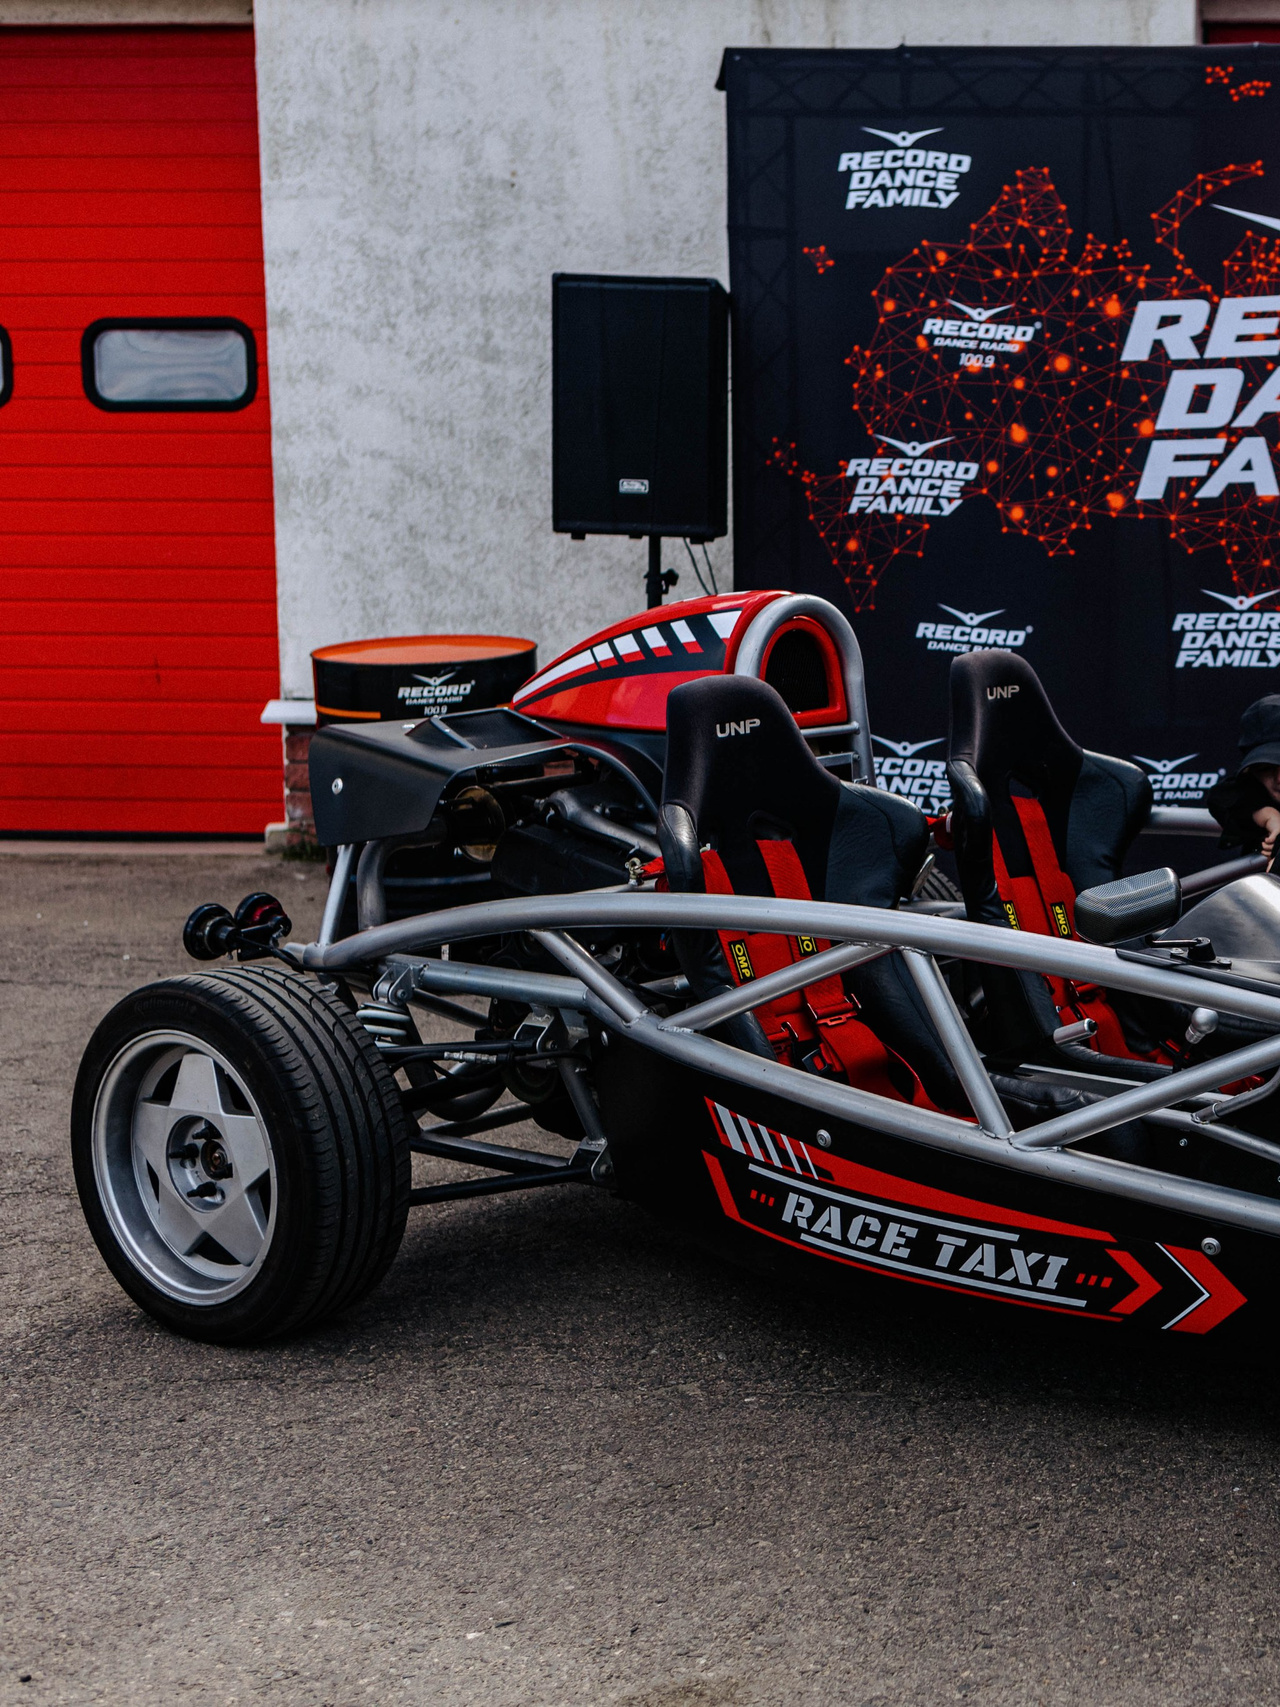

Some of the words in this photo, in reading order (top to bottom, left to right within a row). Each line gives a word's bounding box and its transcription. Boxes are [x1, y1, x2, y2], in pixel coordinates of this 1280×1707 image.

[837, 149, 972, 173] RECORD
[849, 169, 960, 189] DANCE
[845, 189, 960, 210] FAMILY
[922, 318, 1036, 342] RECORD
[933, 337, 979, 349] DANCE
[979, 341, 1020, 352] RADIO
[958, 353, 996, 368] 100.9
[845, 458, 980, 481] RECORD
[854, 477, 966, 497] DANCE
[847, 496, 964, 517] FAMILY
[915, 622, 1027, 647] RECORD
[927, 640, 972, 653] DANCE
[397, 683, 472, 699] RECORD
[986, 685, 1020, 700] UNP
[715, 718, 761, 738] UNP
[876, 775, 952, 798] ANCE
[1147, 773, 1219, 790] CORD
[1163, 790, 1204, 800] RADIO
[1055, 905, 1068, 935] OMP
[735, 943, 751, 978] OMP
[781, 1192, 919, 1259] RACE
[935, 1233, 1069, 1290] TAXI
